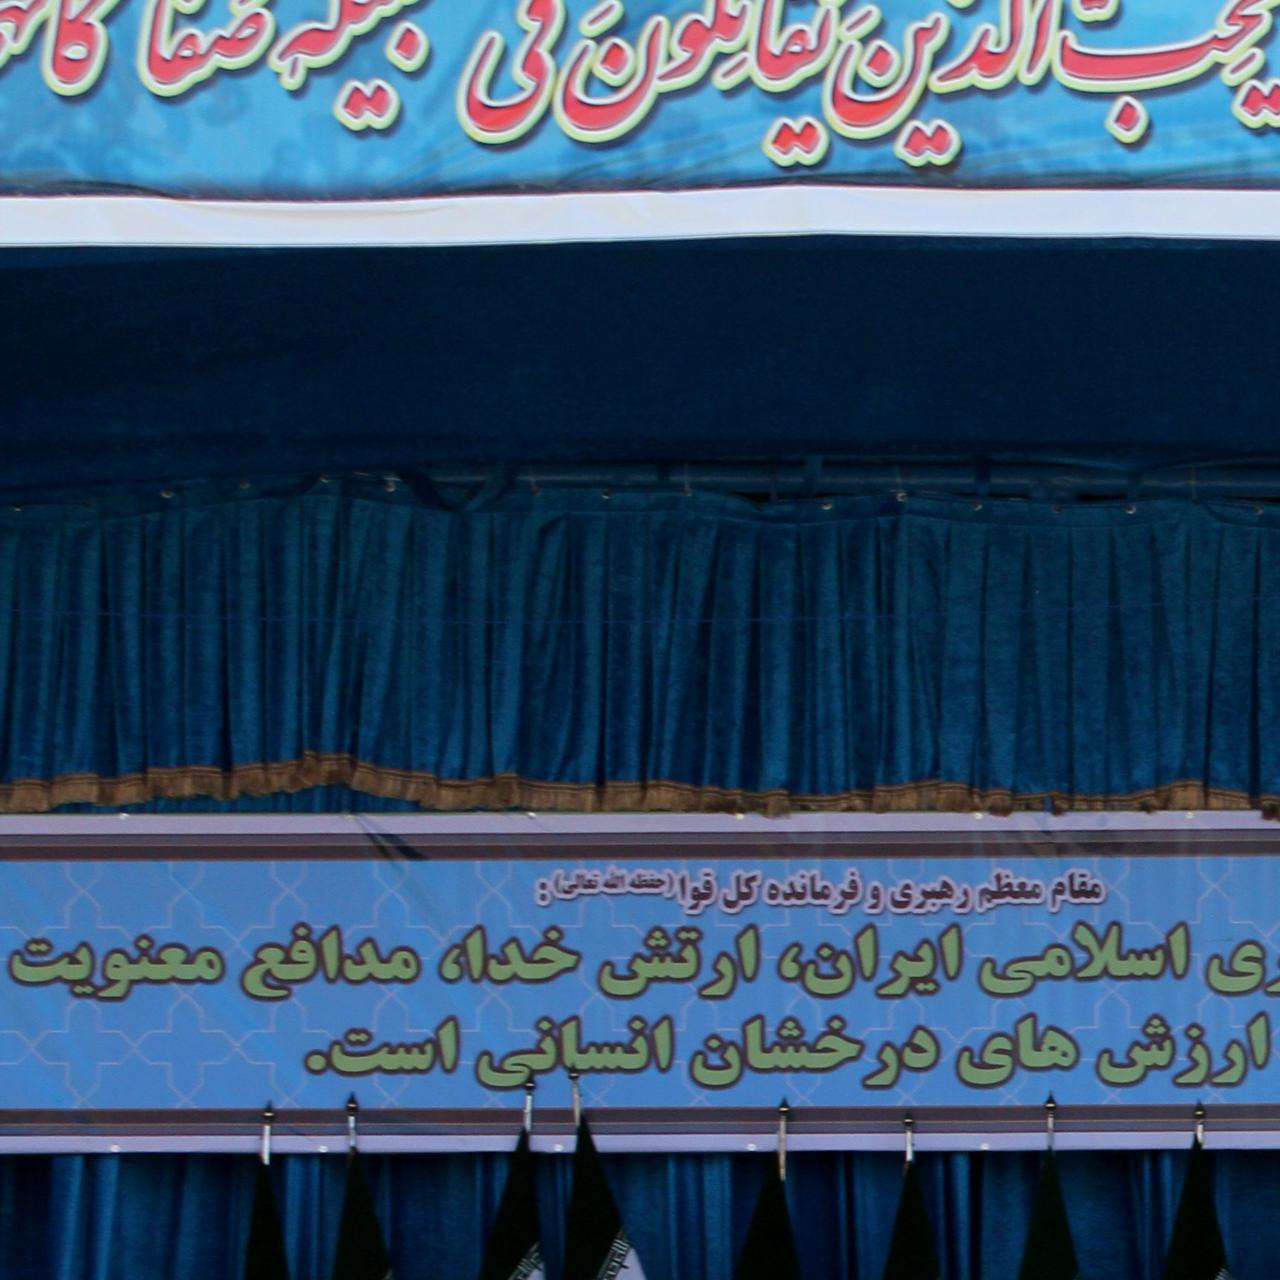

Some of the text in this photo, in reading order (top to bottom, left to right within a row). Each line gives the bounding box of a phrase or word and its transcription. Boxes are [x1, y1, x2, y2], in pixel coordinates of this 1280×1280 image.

[682, 873, 714, 914] قوا
[721, 869, 758, 912] کل
[766, 870, 859, 912] فرمانده
[865, 879, 882, 911] و
[889, 872, 970, 914] رهبری
[977, 870, 1042, 912] معظم
[1048, 871, 1105, 914] مقام
[9, 934, 225, 1000] معنویت
[242, 924, 421, 999] مدافع
[601, 924, 759, 997] ارتش
[778, 922, 960, 996] ایران،
[979, 921, 1189, 995] اسلامی
[305, 1016, 459, 1075] است.
[475, 1016, 672, 1088] انسانی
[691, 1015, 939, 1088] درخشان
[957, 1011, 1079, 1083] های
[1096, 1011, 1270, 1086] ارزش
